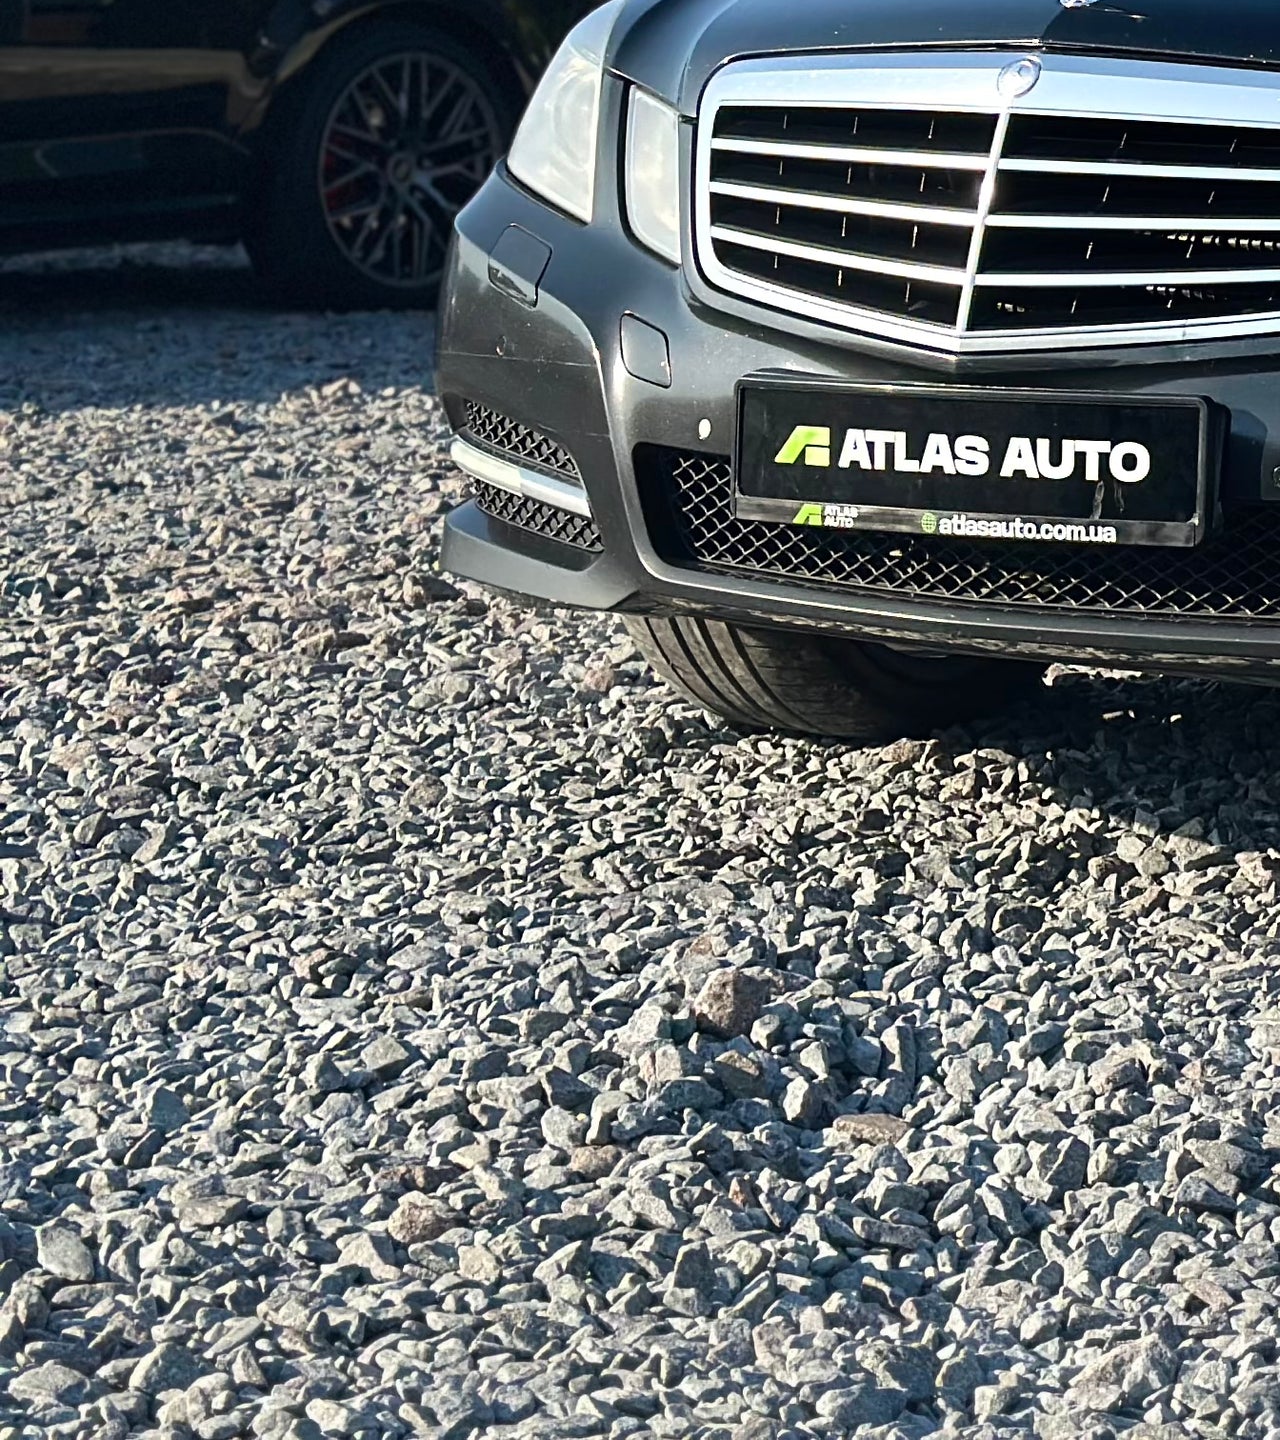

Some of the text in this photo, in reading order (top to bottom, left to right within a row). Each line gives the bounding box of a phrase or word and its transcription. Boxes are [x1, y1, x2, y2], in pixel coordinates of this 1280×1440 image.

[838, 428, 1150, 483] ATLAS AUTO
[824, 505, 858, 518] ATLAS
[824, 516, 854, 528] AUTO
[938, 514, 1117, 543] atlasauto.com.ua
